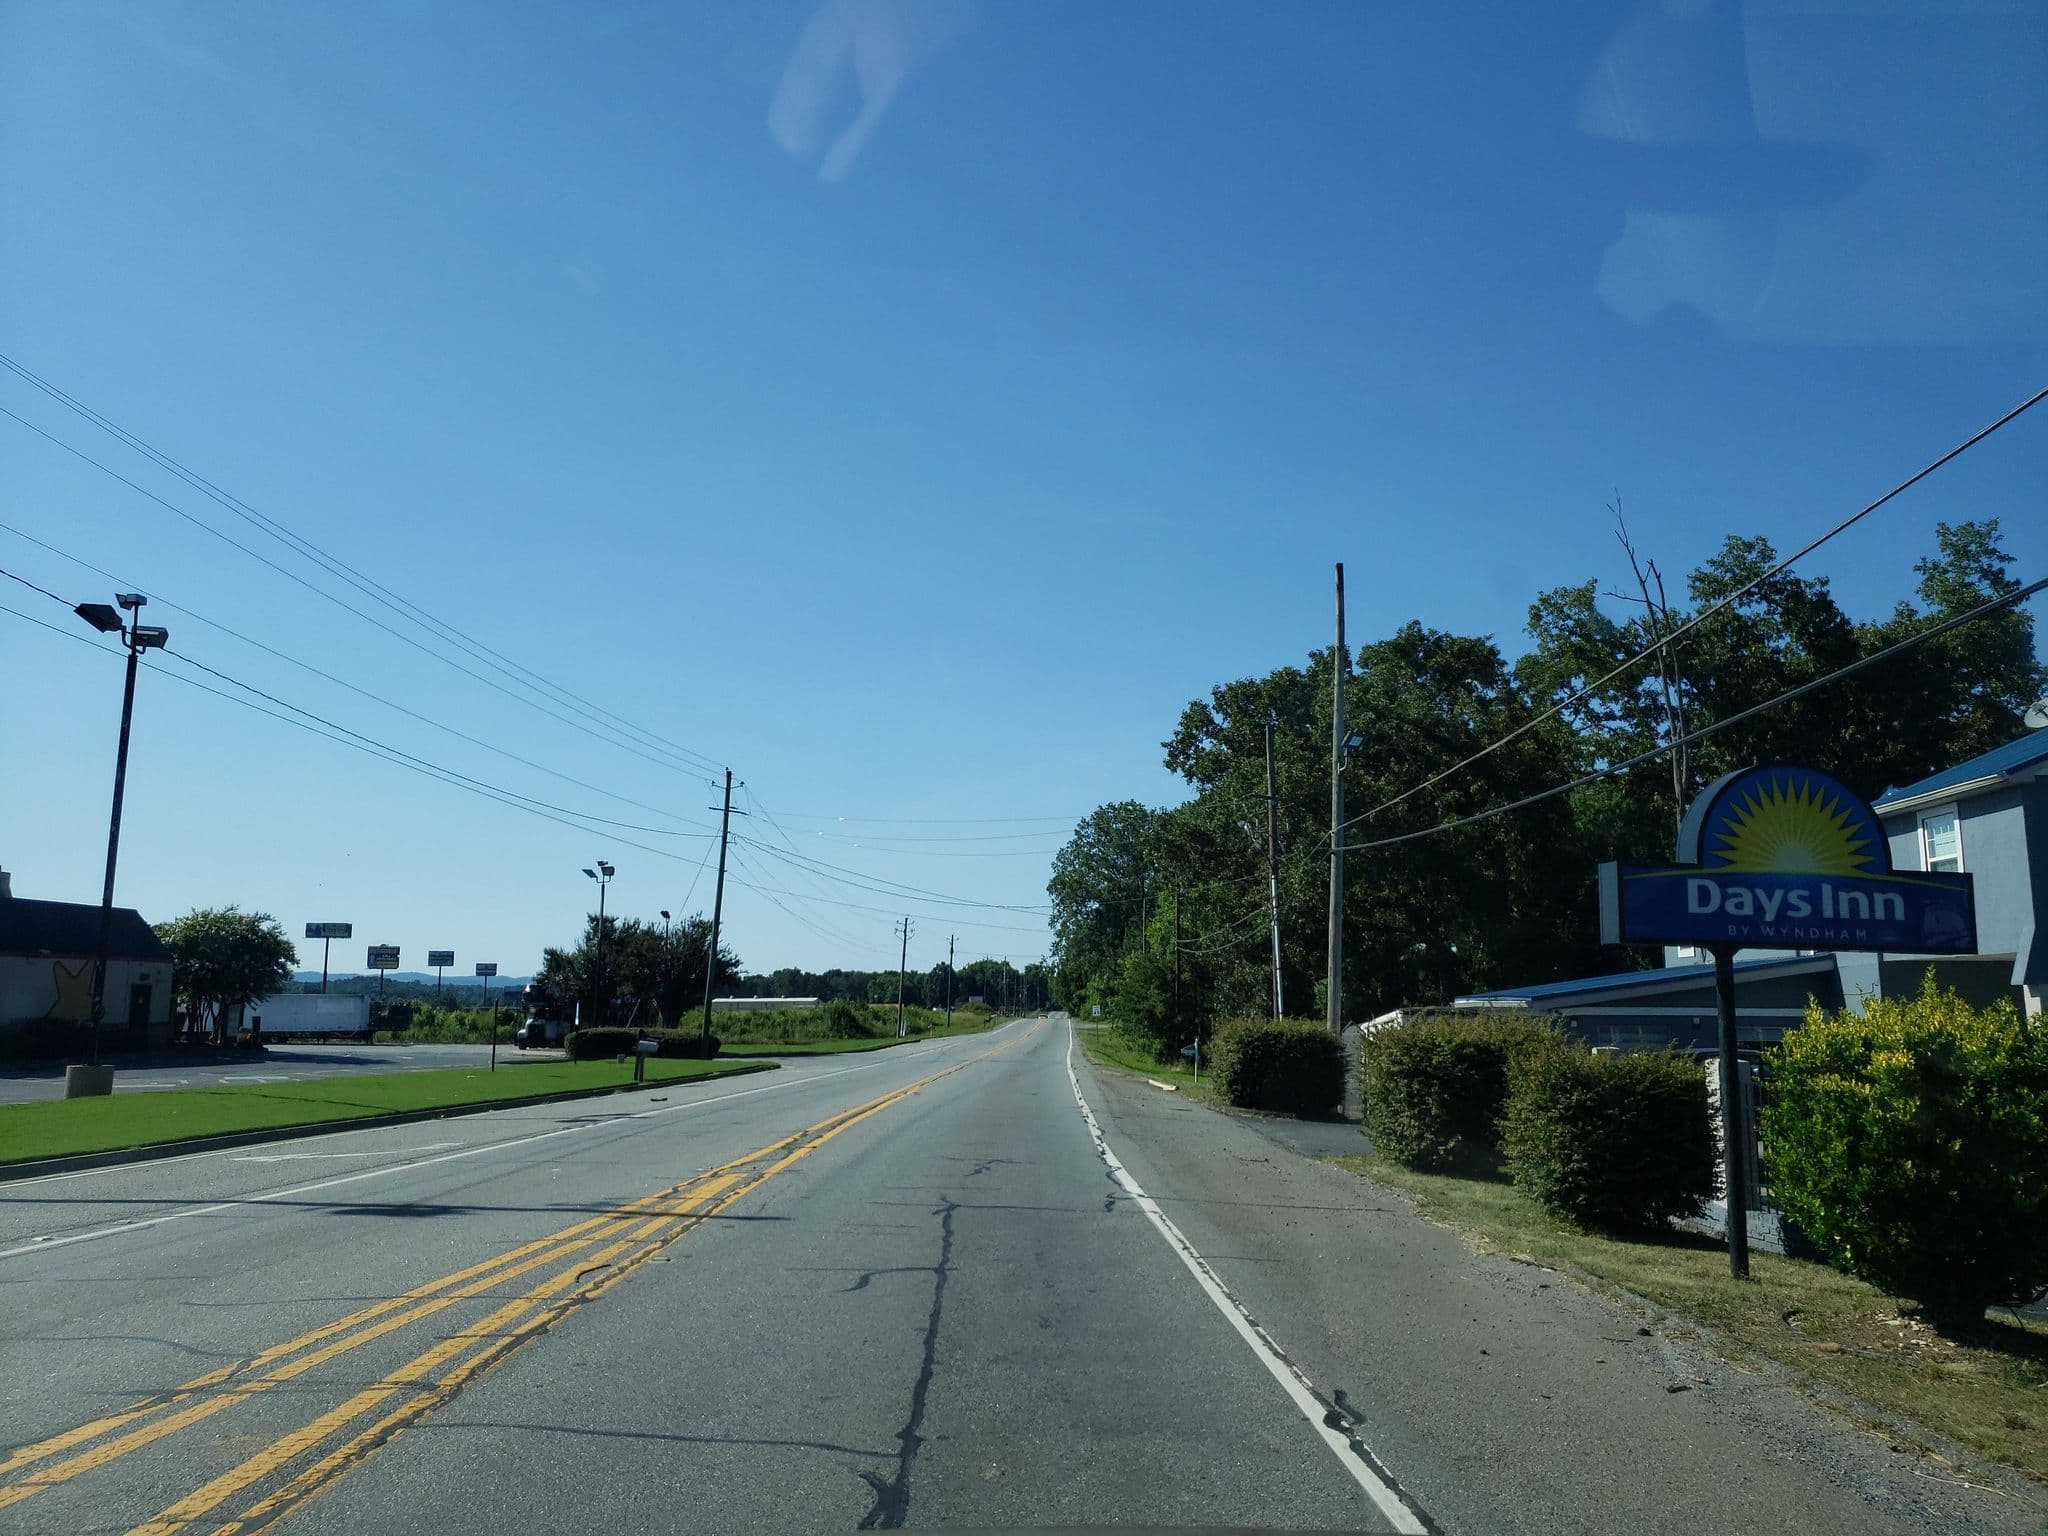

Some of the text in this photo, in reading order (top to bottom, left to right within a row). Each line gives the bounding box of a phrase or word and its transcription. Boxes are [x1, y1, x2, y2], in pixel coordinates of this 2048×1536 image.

[1688, 879, 1905, 921] Days Inn
[1729, 925, 1867, 940] BY WYNDHAM
